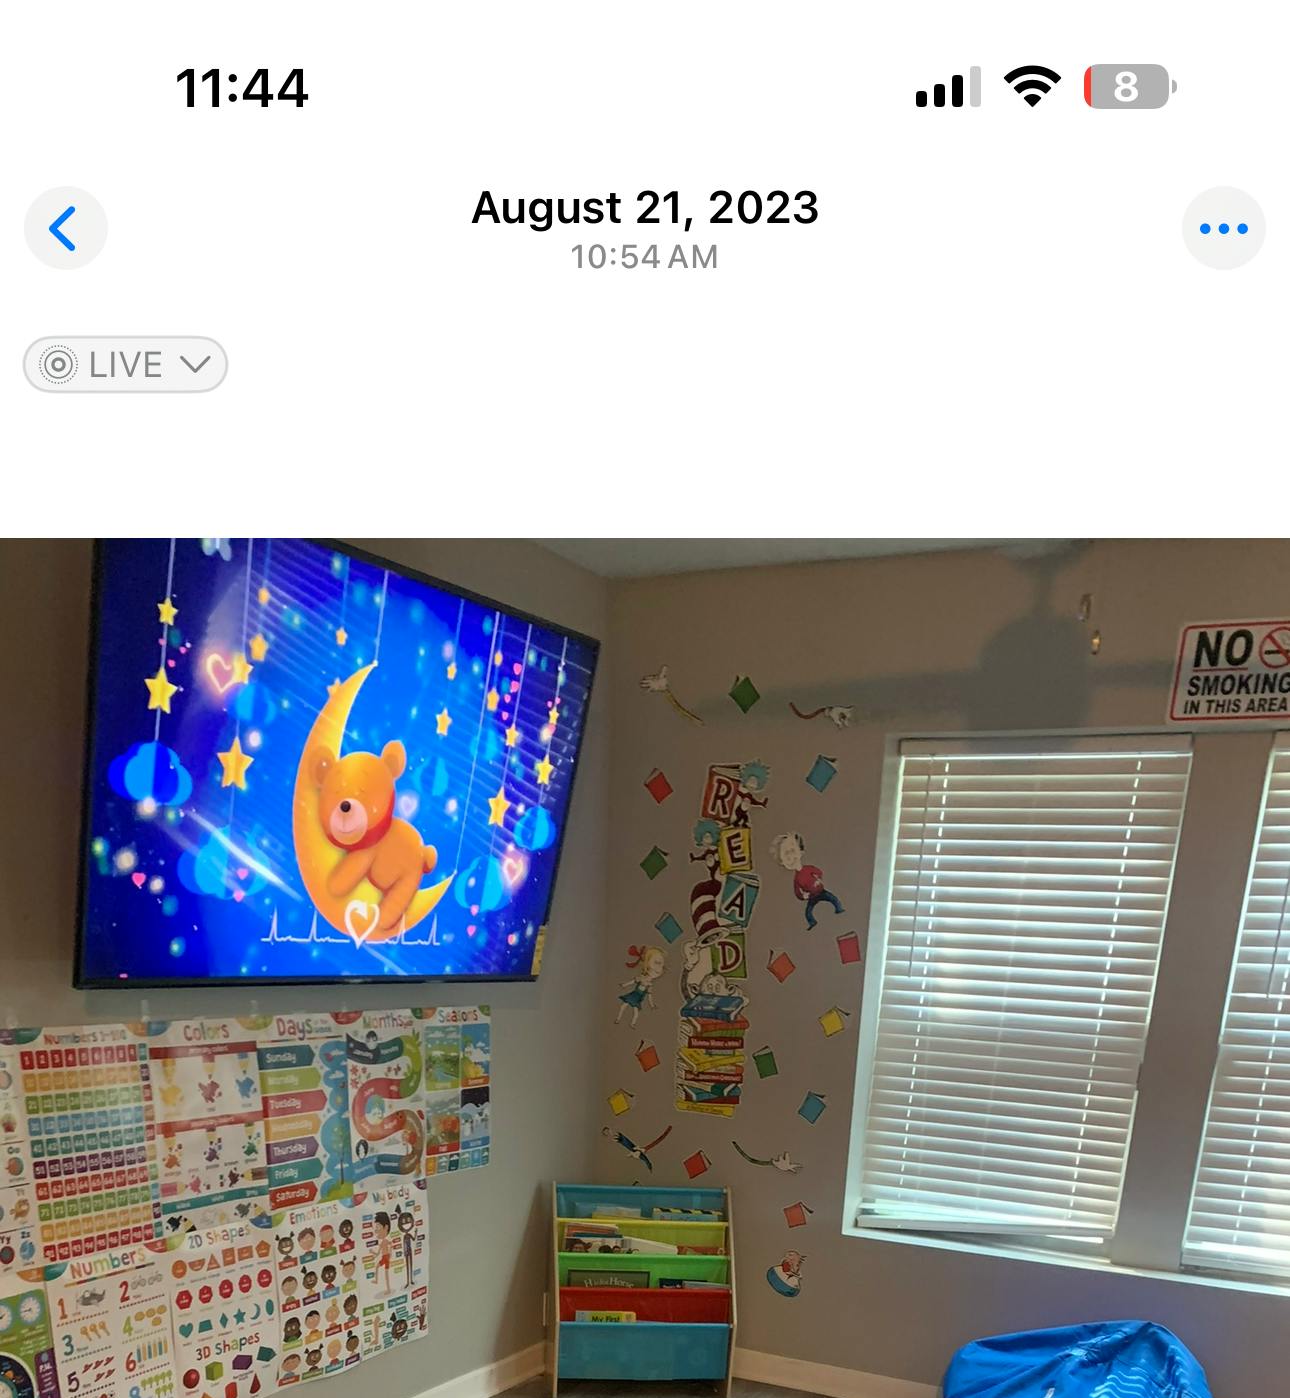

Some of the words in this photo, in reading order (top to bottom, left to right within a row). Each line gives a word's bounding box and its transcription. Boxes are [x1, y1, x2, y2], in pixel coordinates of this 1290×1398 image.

[1193, 629, 1254, 668] NO
[1187, 671, 1290, 696] SMOKING
[1183, 700, 1200, 714] IN
[1206, 699, 1241, 713] THIS
[1245, 697, 1288, 713] AREA
[438, 1010, 478, 1023] Seasons
[183, 1021, 230, 1040] Colors
[276, 1016, 312, 1040] Days
[266, 1052, 296, 1064] Sunday
[269, 1098, 301, 1110] Tuesday
[273, 1143, 307, 1156] Thursday
[275, 1168, 298, 1179] Friday
[276, 1188, 309, 1202] Saturday
[290, 1204, 338, 1225] Emotions
[188, 1234, 203, 1249] 2D
[206, 1224, 250, 1245] Shapes
[70, 1250, 146, 1279] Numbers
[119, 1281, 130, 1303] 2
[58, 1298, 68, 1320] 1
[122, 1315, 133, 1337] 4
[62, 1334, 75, 1356] 3
[195, 1345, 212, 1361] 3D
[214, 1332, 261, 1356] Shapes
[125, 1352, 136, 1373] 6
[67, 1371, 80, 1393] 5
